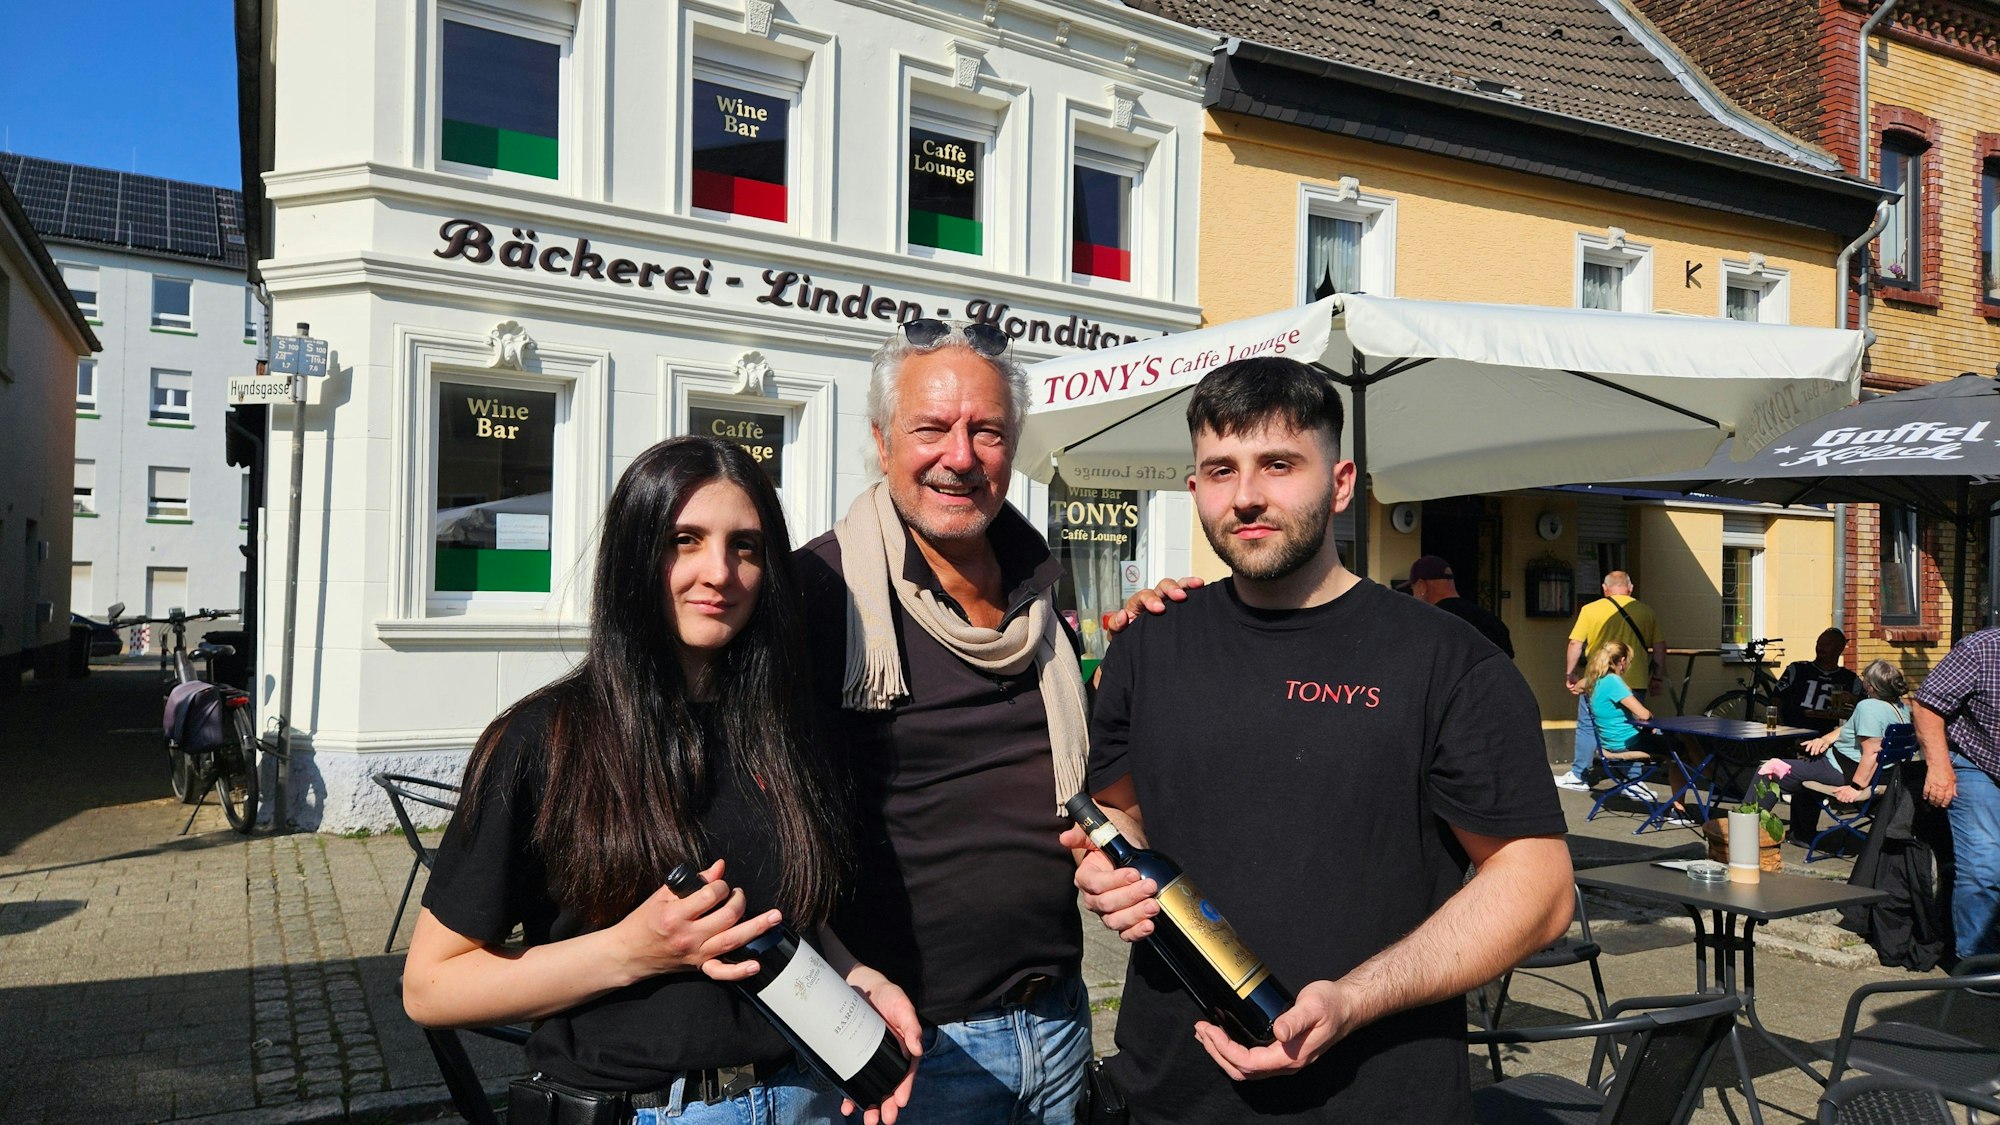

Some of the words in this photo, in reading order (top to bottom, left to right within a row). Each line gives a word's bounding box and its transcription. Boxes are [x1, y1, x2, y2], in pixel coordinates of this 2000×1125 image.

[716, 94, 768, 122] Wine
[724, 115, 760, 138] Bar
[922, 140, 967, 163] Caffè
[914, 154, 975, 185] Lounge
[433, 219, 713, 295] Bäckerei
[757, 269, 922, 322] Linden
[278, 340, 286, 350] S
[306, 343, 314, 352] S
[1044, 355, 1163, 404] TONY'S
[1169, 350, 1220, 376] Caffè
[1228, 329, 1301, 364] Lounge
[230, 380, 290, 399] Hundsgasse
[467, 397, 529, 420] Wine
[476, 418, 520, 439] Bar
[711, 419, 764, 439] Caffè
[1811, 420, 1991, 447] Gaffel
[1068, 486, 1098, 498] Wine
[1101, 488, 1122, 499] Bar
[1050, 501, 1139, 528] TONY'S
[1061, 528, 1088, 541] Caffè
[1090, 529, 1128, 545] Lounge
[1286, 680, 1380, 708] TONY'S
